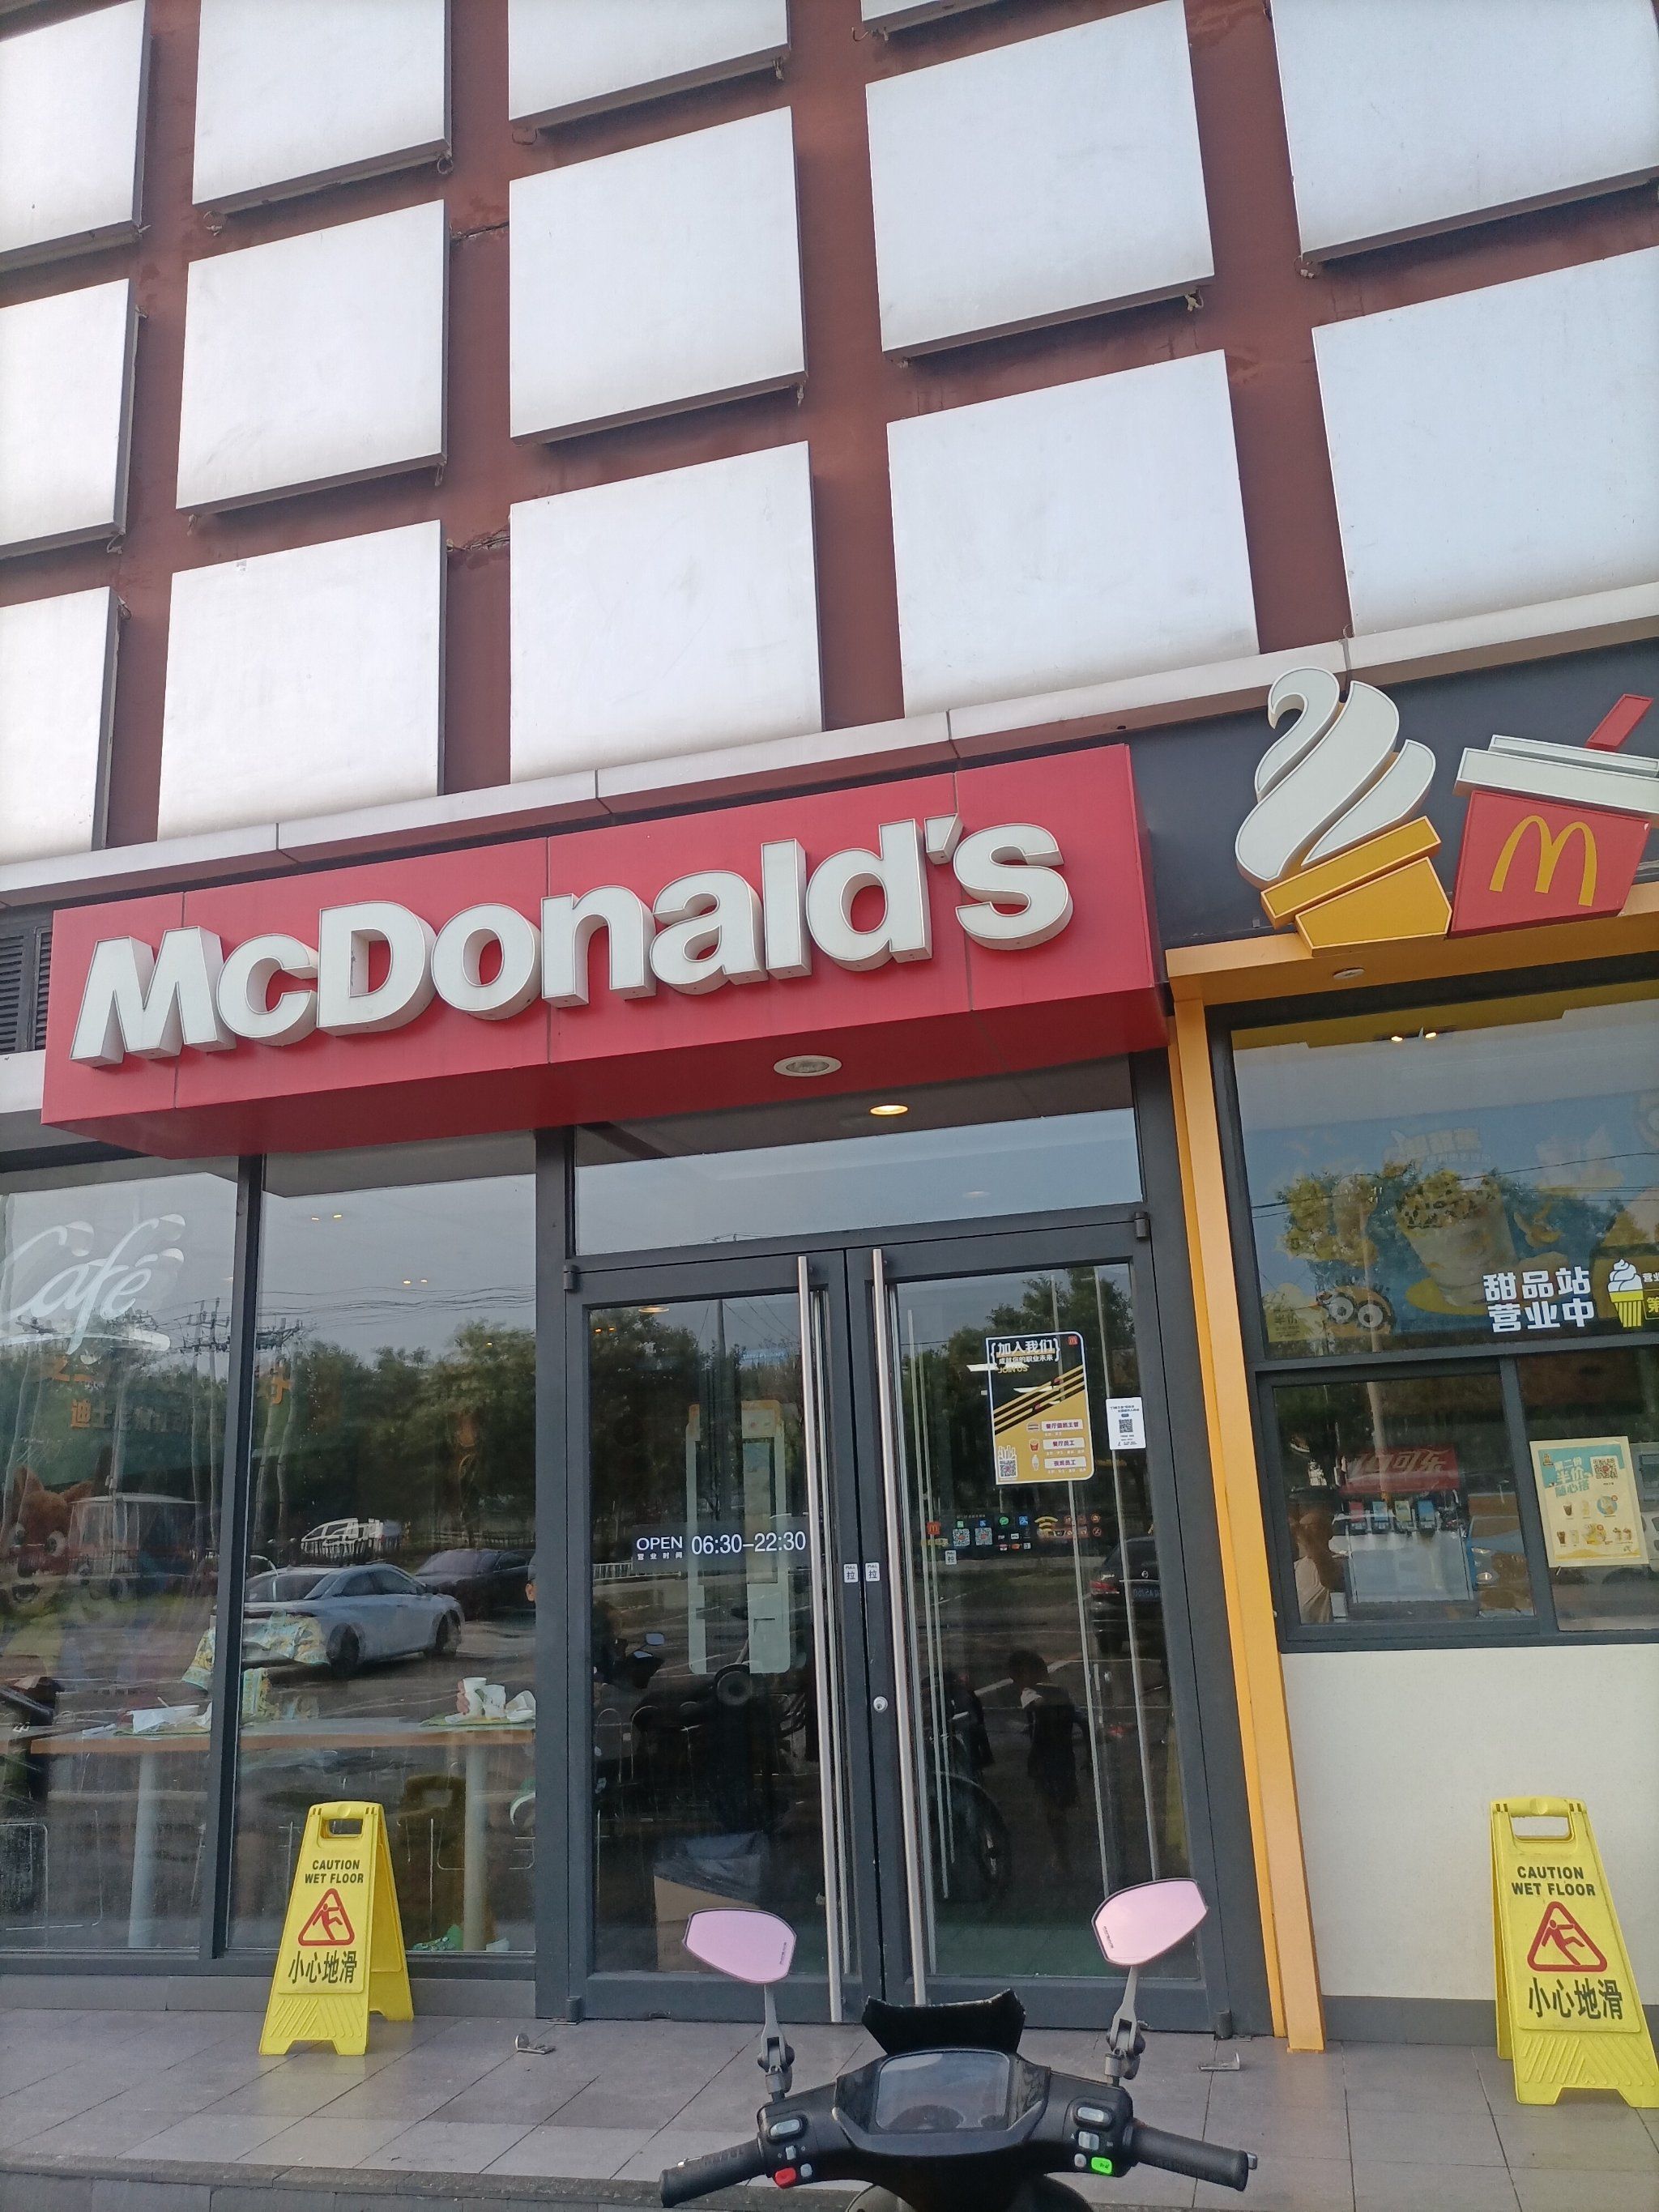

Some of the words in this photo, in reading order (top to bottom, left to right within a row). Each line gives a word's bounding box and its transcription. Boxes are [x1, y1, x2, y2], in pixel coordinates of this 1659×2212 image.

[70, 813, 1074, 1067] McDonald's
[1482, 1266, 1592, 1302] 甜品站
[1487, 1298, 1595, 1333] 营业中
[997, 1339, 1054, 1356] 加入我们
[636, 1536, 683, 1551] OPEN
[637, 1551, 683, 1561] 营业时间
[847, 1571, 855, 1580] 拉
[868, 1570, 877, 1579] 拉
[312, 1859, 360, 1870] CAUTION
[305, 1873, 327, 1884] WET
[330, 1873, 364, 1884] FLOOR
[1516, 1865, 1584, 1879] CAUTION
[1511, 1882, 1542, 1895] WET
[1547, 1882, 1596, 1896] FLOOR
[288, 1950, 357, 1984] 小心地滑
[1529, 1976, 1623, 2020] 小心地滑
